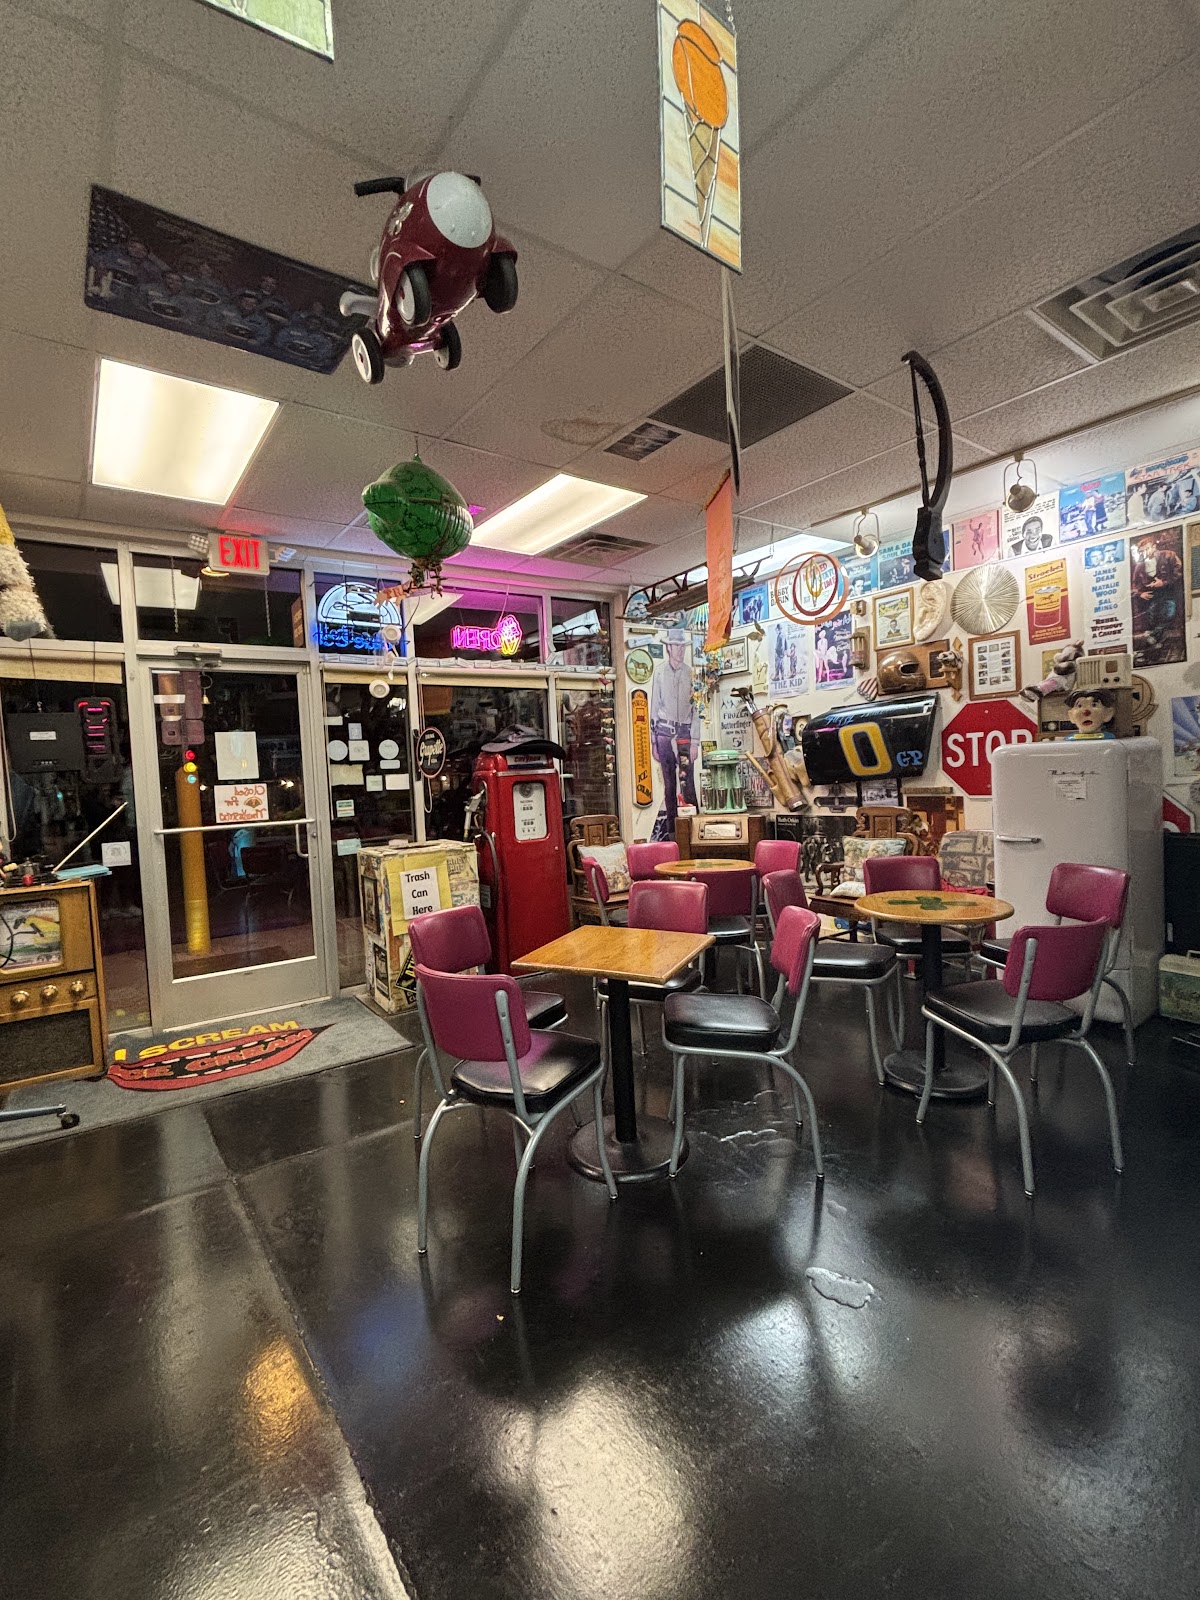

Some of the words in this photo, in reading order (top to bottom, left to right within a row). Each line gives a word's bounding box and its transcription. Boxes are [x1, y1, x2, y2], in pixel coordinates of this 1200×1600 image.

[1134, 470, 1160, 481] STAR
[1164, 462, 1190, 475] TREK
[218, 535, 262, 570] EXIT
[879, 547, 894, 556] SAM
[901, 541, 912, 550] DA
[882, 552, 899, 560] SOUL
[900, 548, 912, 557] ME
[1028, 562, 1064, 581] Stroebel
[1093, 567, 1117, 577] JAMES
[1095, 574, 1115, 583] DEAN
[770, 586, 789, 598] BBBY
[1091, 582, 1120, 592] NATALIE
[1095, 588, 1118, 598] WOOD
[770, 595, 789, 607] DRIN
[1098, 598, 1112, 606] SAL
[1094, 603, 1118, 613] MINEO
[1090, 622, 1123, 632] WITHOUT
[721, 720, 751, 731] Butterfinger
[405, 871, 431, 883] Trash
[411, 889, 429, 899] Can
[412, 905, 434, 916] Here
[114, 1048, 127, 1061] I
[139, 1020, 300, 1059] SCREAM
[185, 1028, 313, 1072] CREAM
